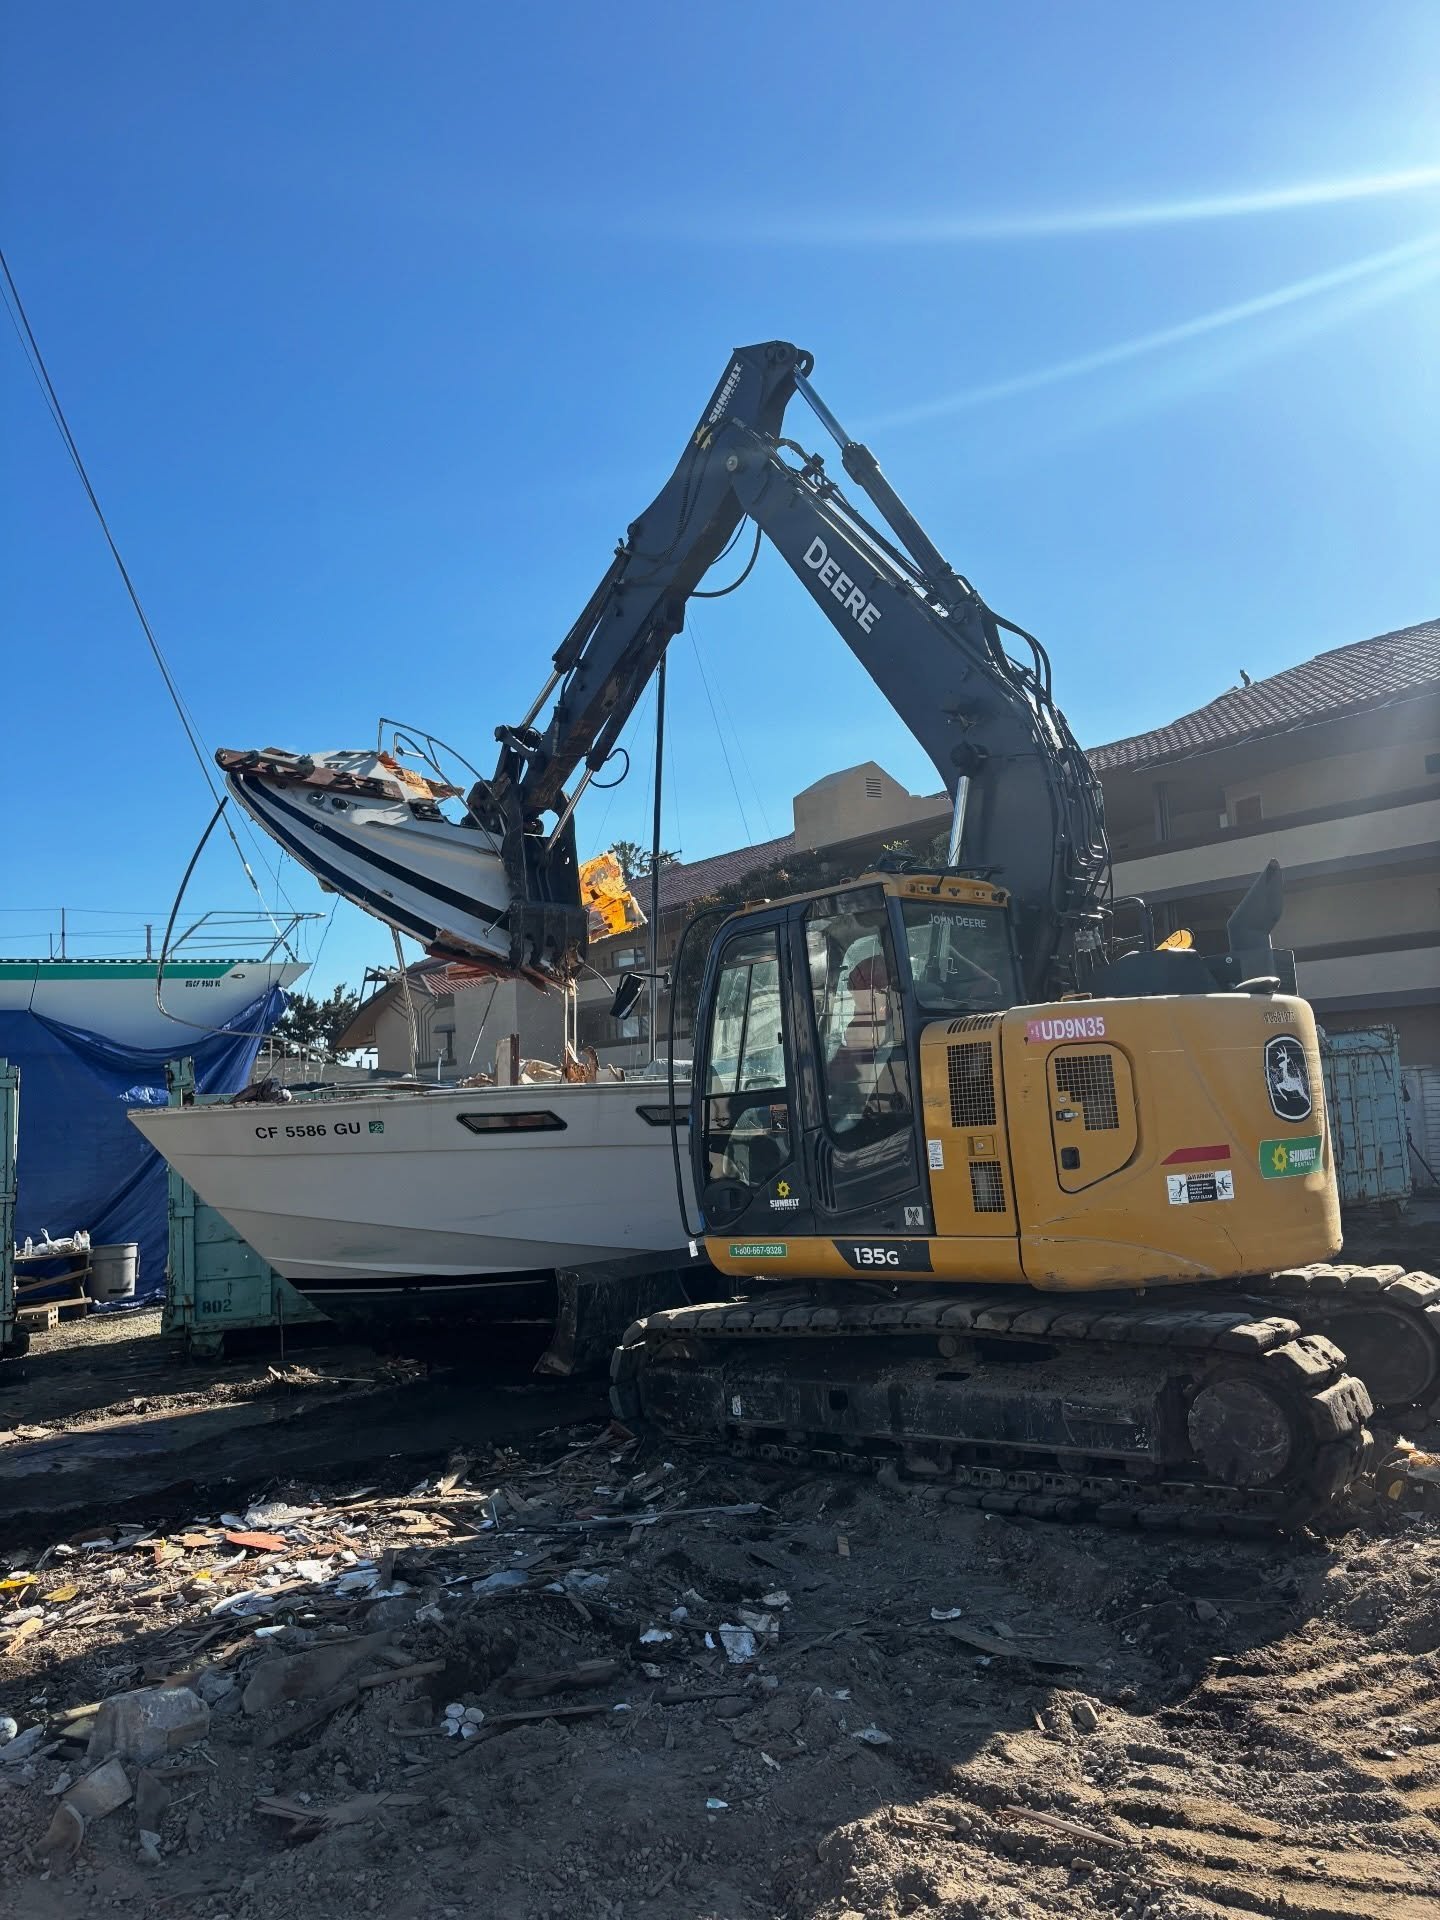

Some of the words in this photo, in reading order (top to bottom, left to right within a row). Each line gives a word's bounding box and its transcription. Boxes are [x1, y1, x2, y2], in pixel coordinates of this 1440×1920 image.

[708, 362, 742, 424] SUNBELT
[802, 535, 882, 634] DEERE
[928, 911, 954, 926] JOHN
[955, 915, 987, 928] DEERE
[1041, 1016, 1105, 1040] UD9N35
[255, 1127, 278, 1139] CF
[285, 1124, 327, 1138] 5586
[333, 1121, 361, 1135] GU
[1289, 1147, 1317, 1163] SUNBELT
[769, 1198, 800, 1208] SUNBELT
[853, 1247, 900, 1265] 135G
